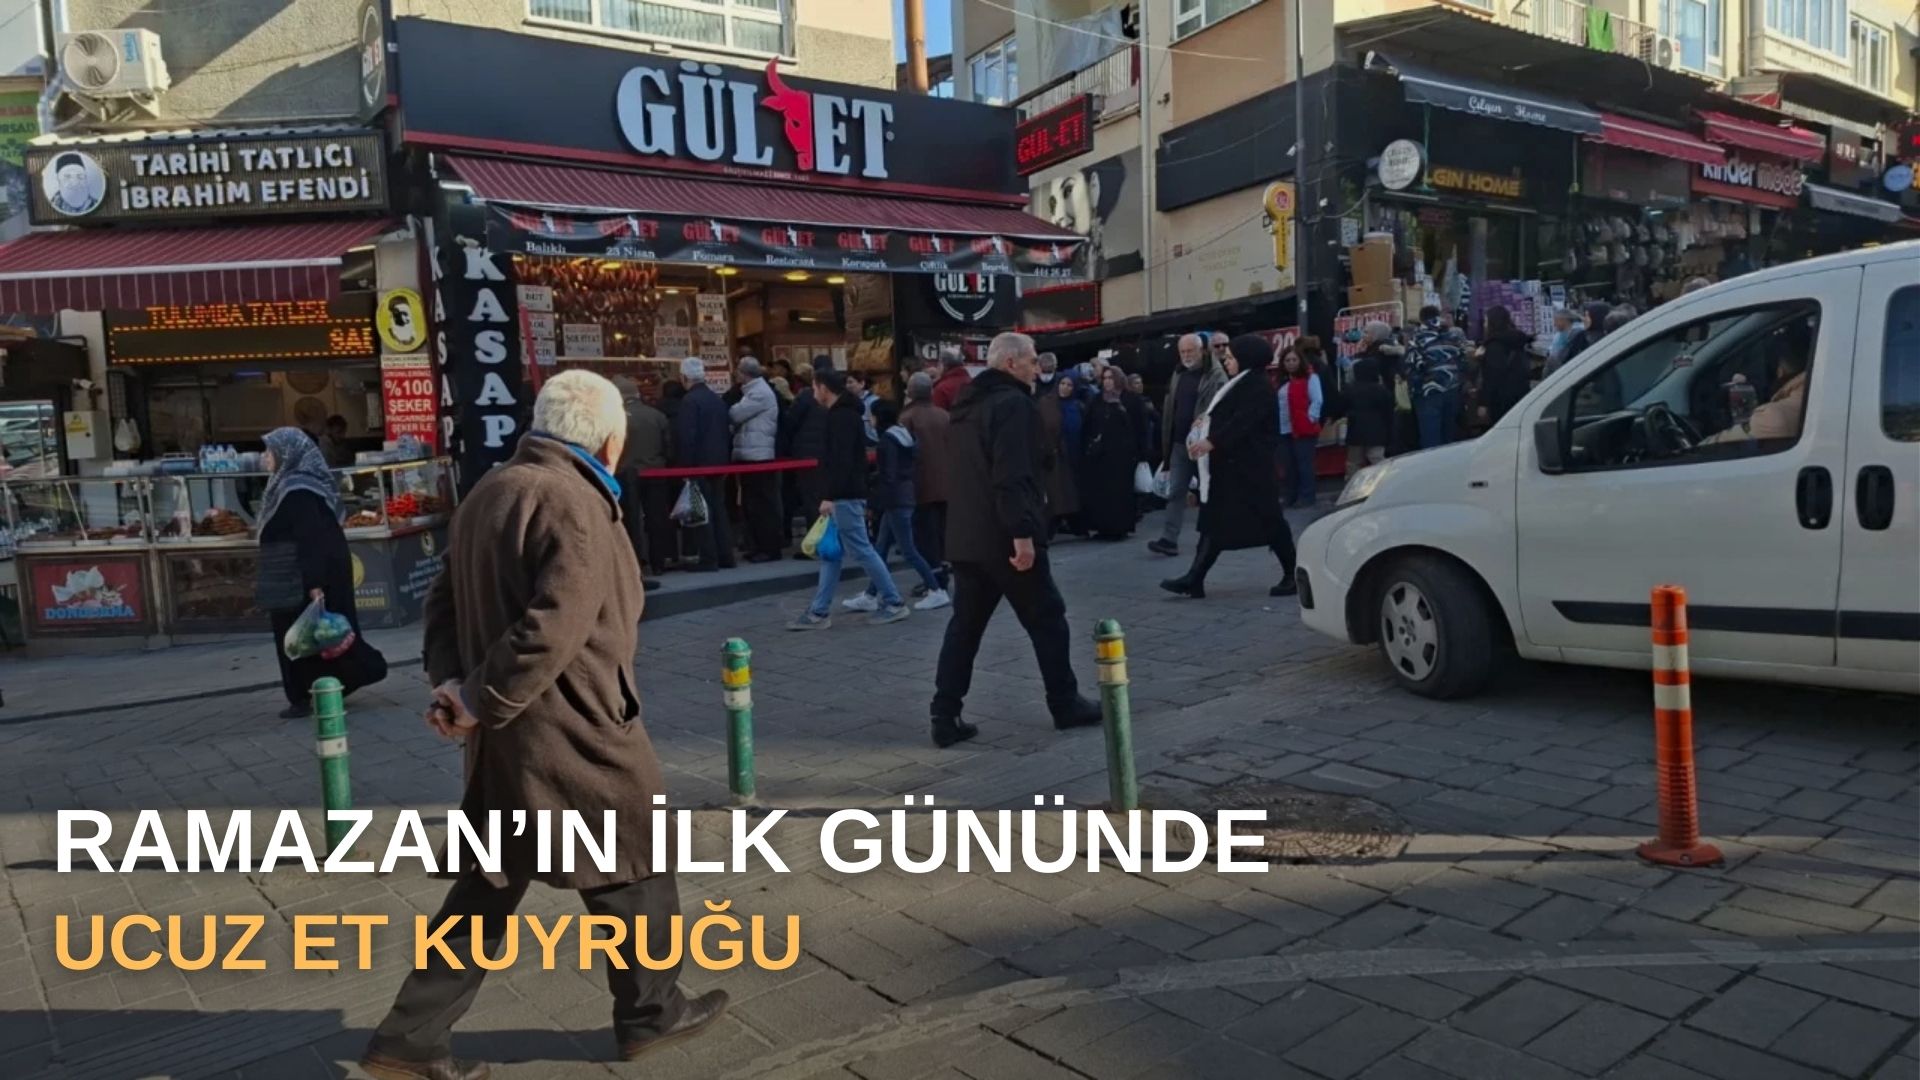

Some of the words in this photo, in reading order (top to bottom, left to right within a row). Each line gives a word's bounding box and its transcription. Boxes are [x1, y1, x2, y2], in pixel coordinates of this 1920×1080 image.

[130, 142, 231, 176] TARİHİ
[239, 143, 354, 171] TATLICI
[119, 174, 250, 210] İBRAHİM
[261, 167, 370, 202] EFENDİ
[1467, 173, 1520, 197] HOME
[463, 246, 517, 448] KASAP
[384, 379, 433, 397] %100
[388, 398, 433, 415] ŞEKER
